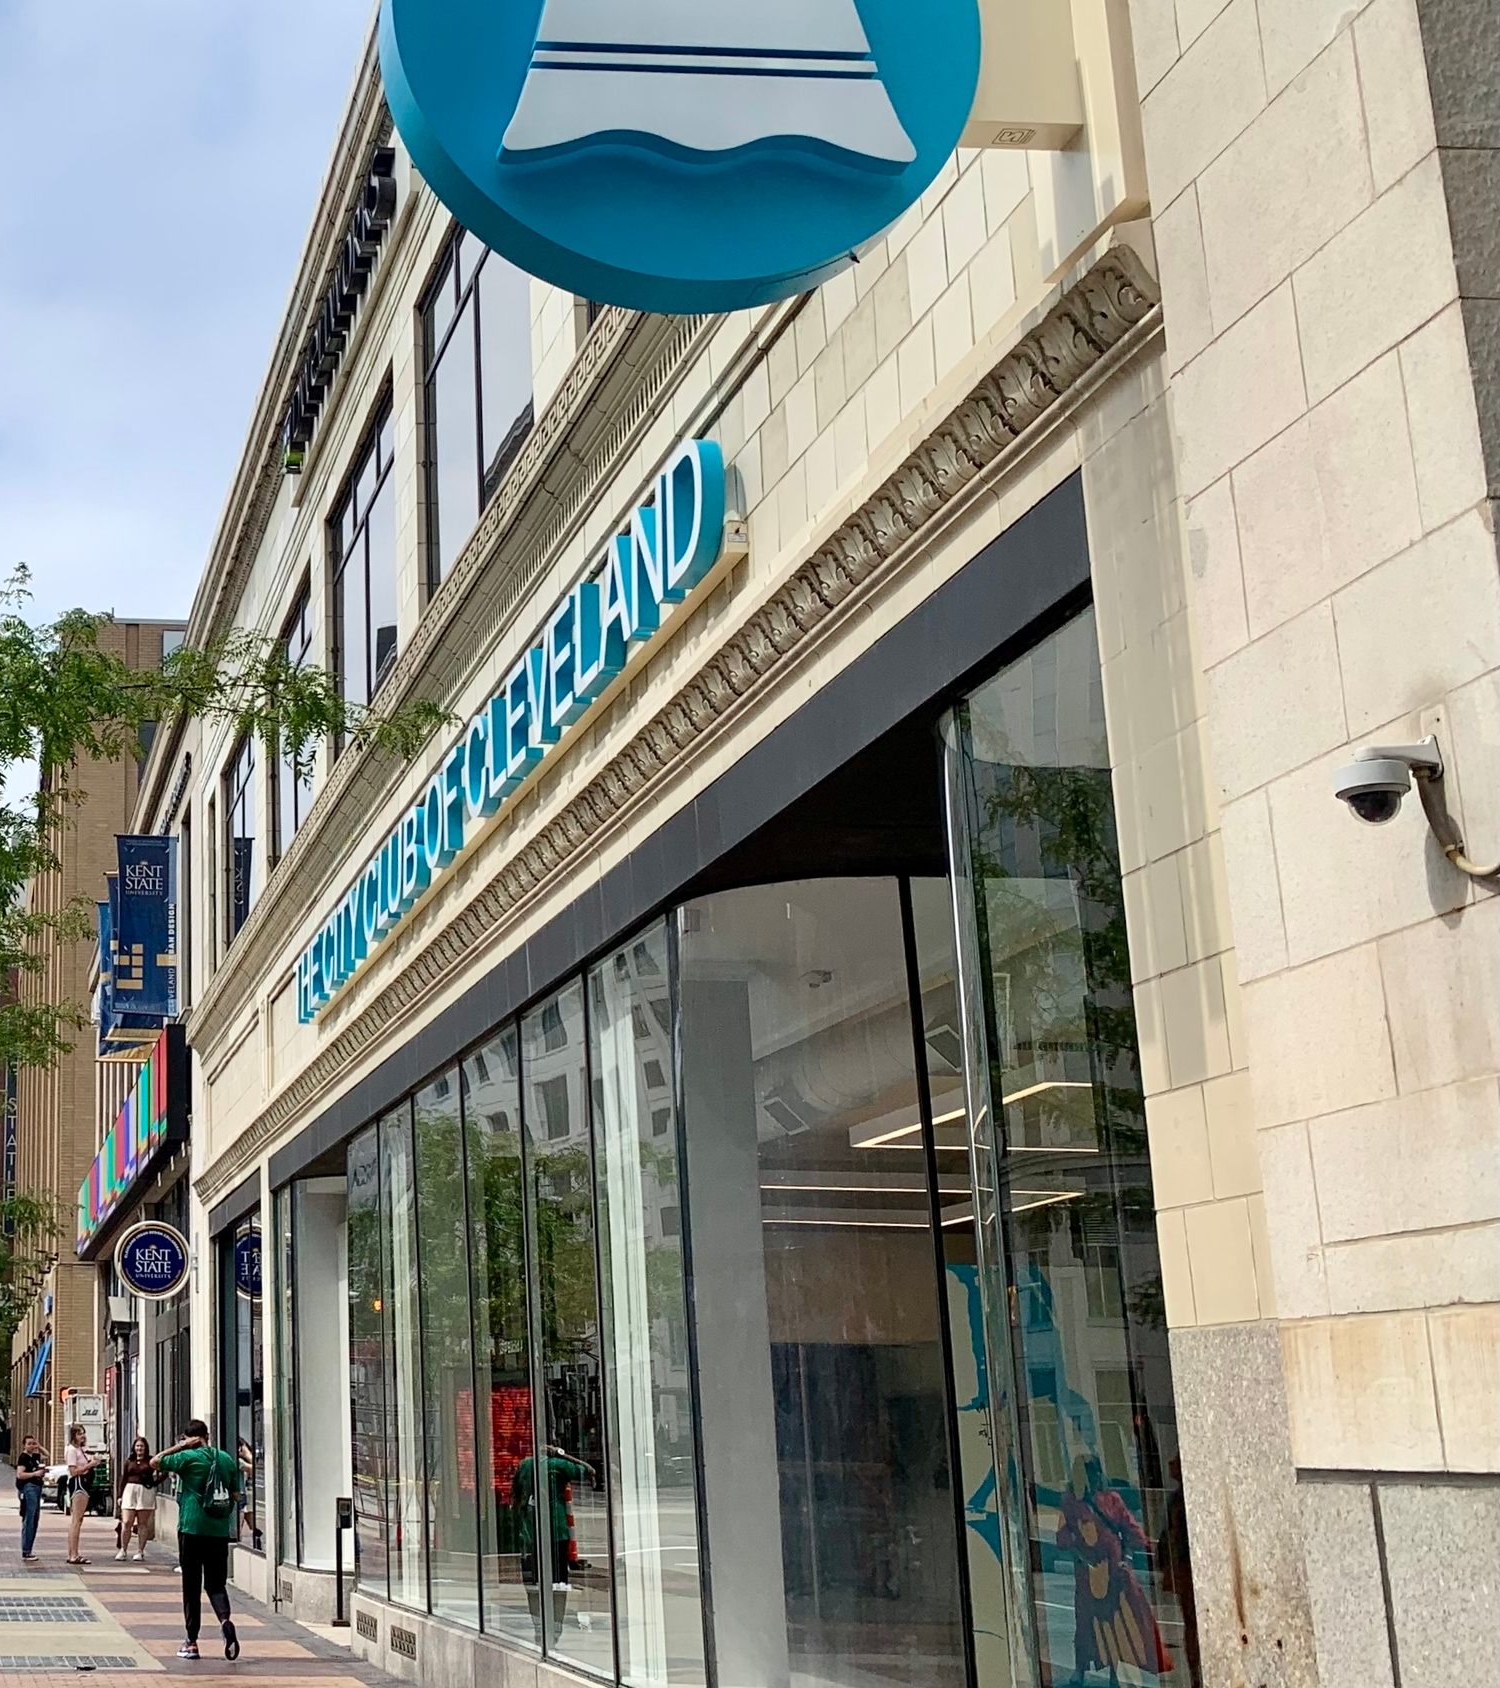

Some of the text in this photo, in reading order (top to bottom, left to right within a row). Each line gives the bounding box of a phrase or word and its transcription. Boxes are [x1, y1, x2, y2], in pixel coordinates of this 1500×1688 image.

[292, 439, 726, 1025] THE CITY CLUB OF CLEVELAND
[125, 864, 164, 878] KENT
[125, 877, 164, 890] STATE
[167, 903, 175, 935] DESIGN
[135, 1248, 172, 1261] KENT
[135, 1260, 172, 1274] STATE
